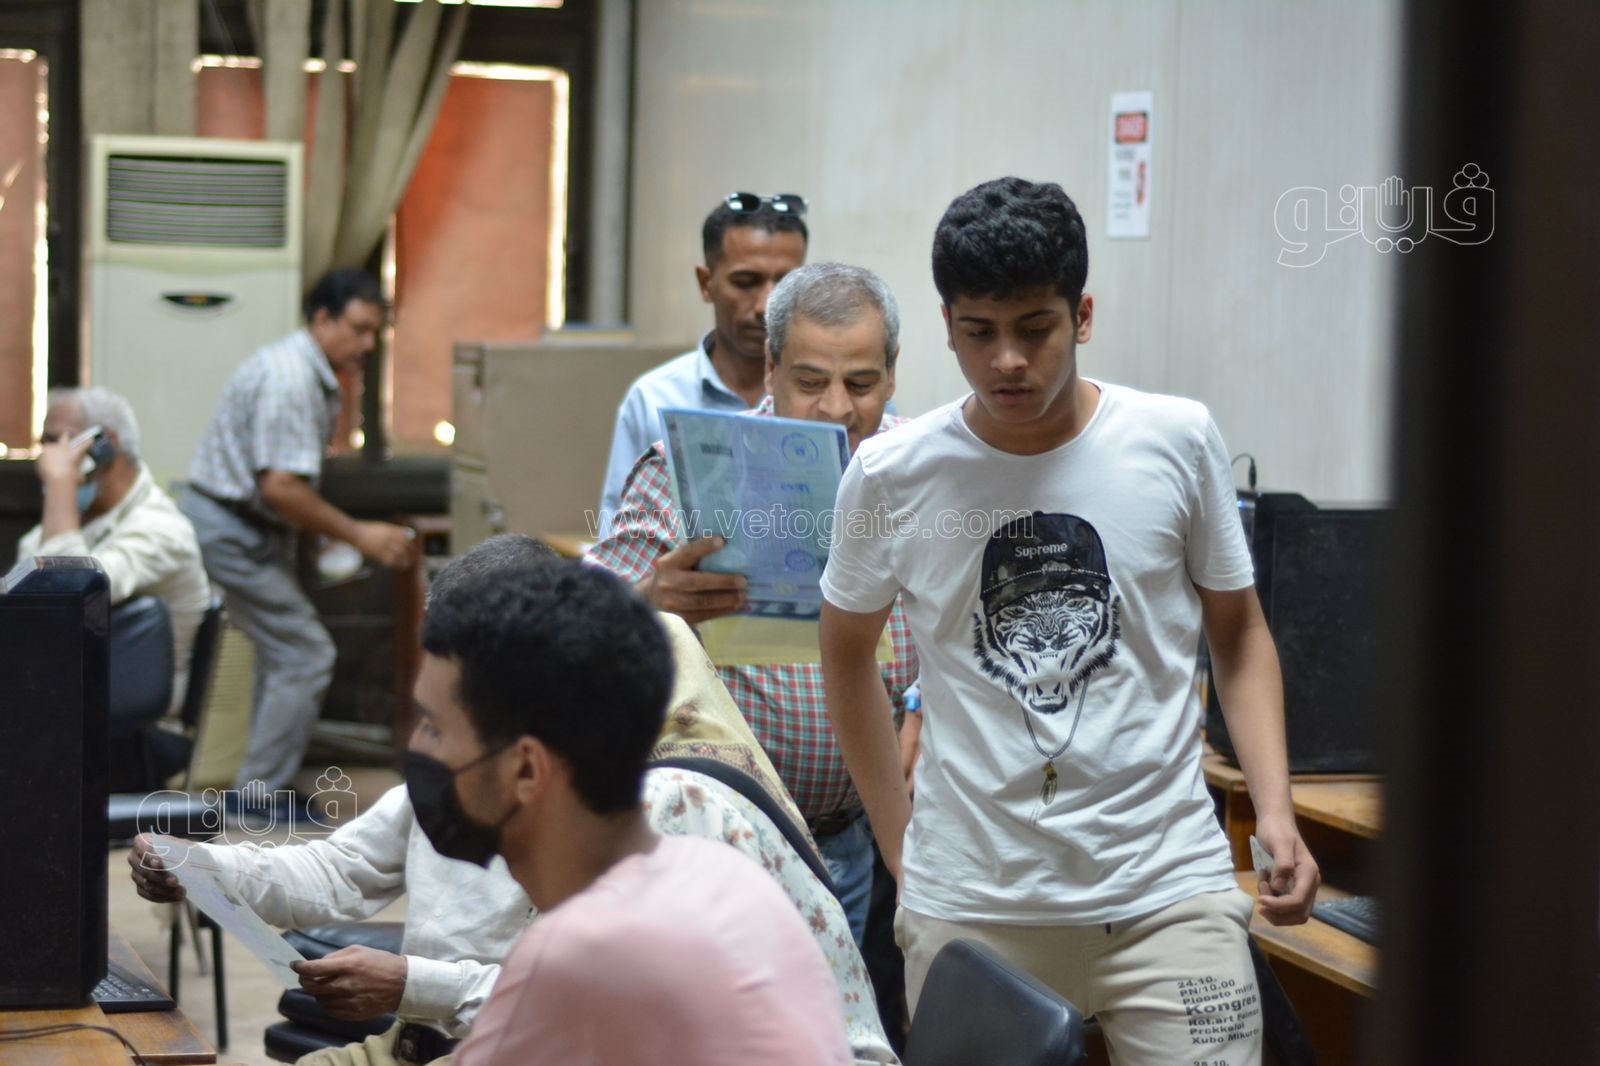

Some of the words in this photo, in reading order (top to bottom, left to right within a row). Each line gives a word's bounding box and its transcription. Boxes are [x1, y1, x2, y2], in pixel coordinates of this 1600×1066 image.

[1015, 542, 1068, 559] Supreme
[1180, 979, 1235, 997] PN/10.00
[1185, 995, 1257, 1015] Kongres
